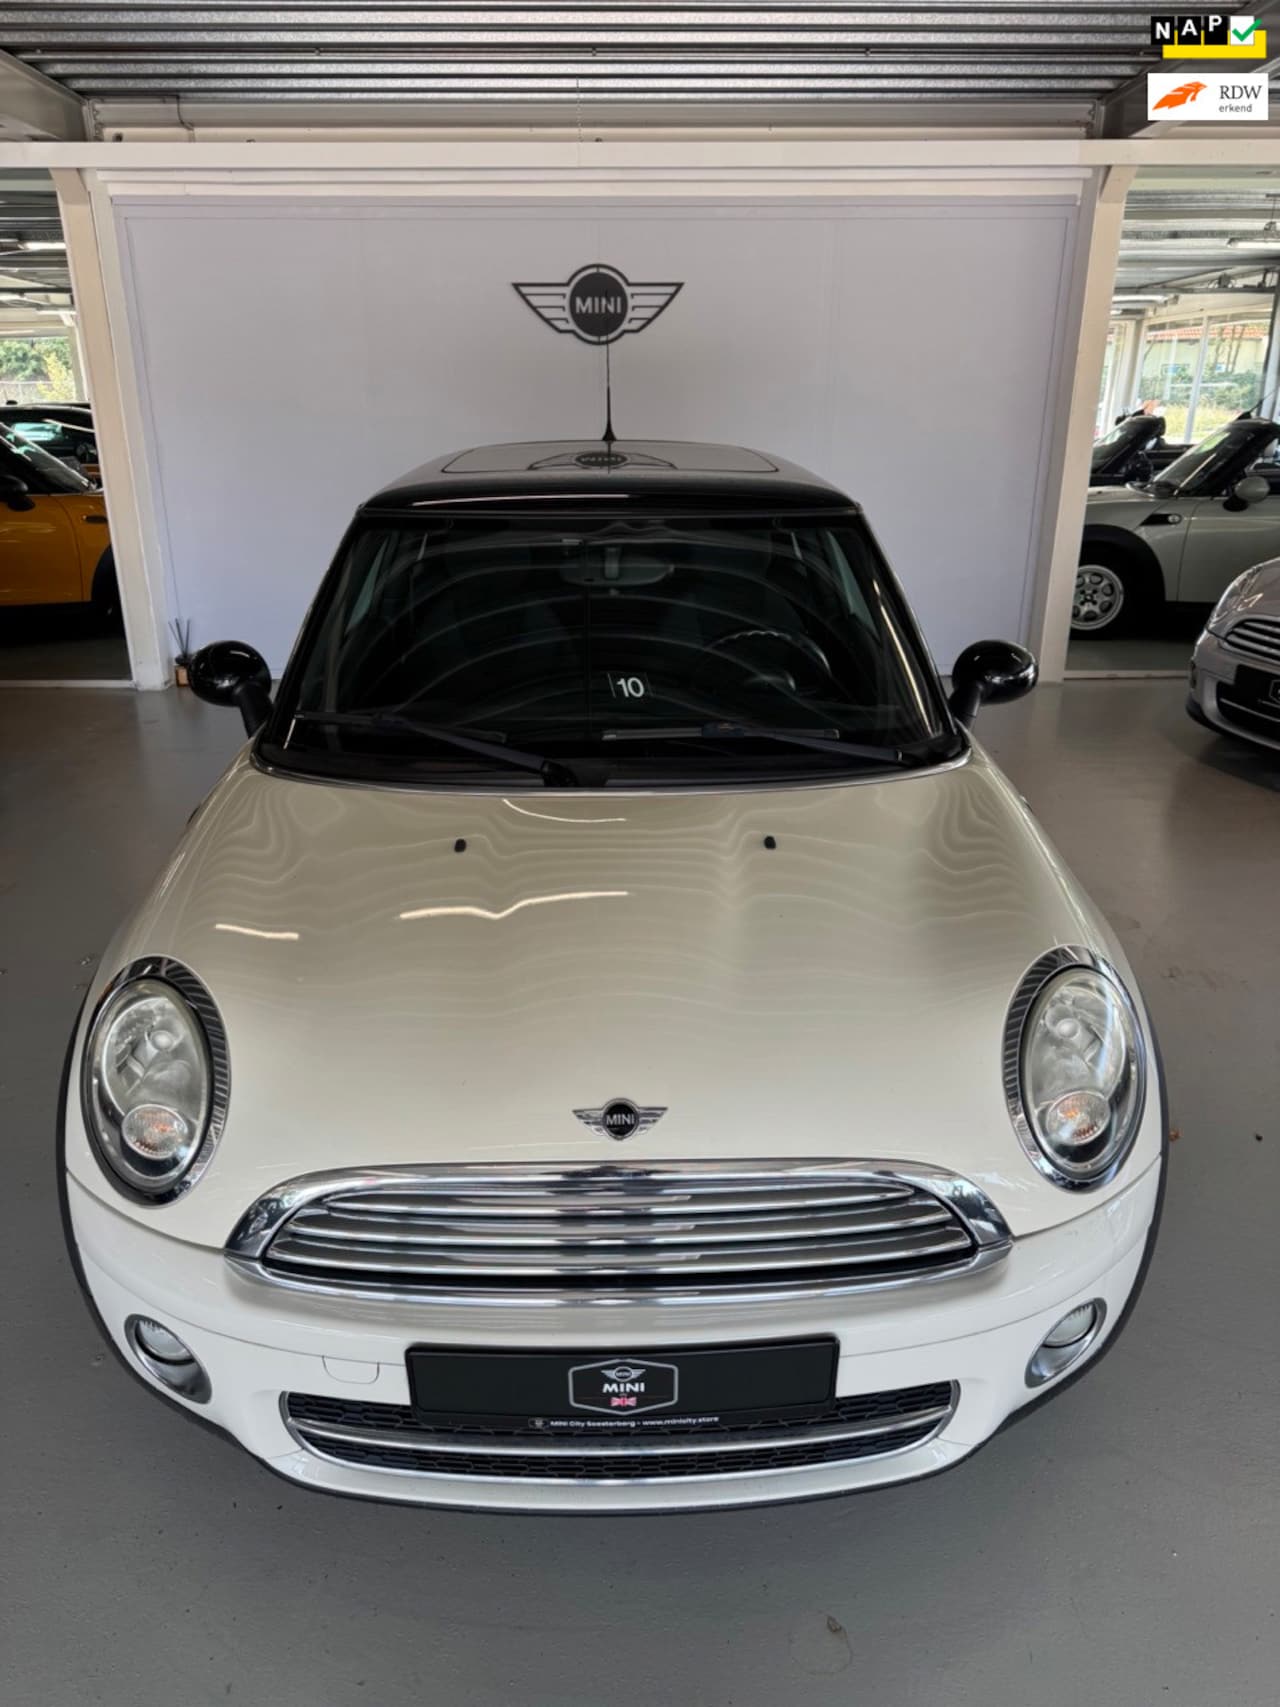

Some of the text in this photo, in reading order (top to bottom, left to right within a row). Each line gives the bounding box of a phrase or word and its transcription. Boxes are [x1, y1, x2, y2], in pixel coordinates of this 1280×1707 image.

[575, 297, 622, 314] MINI
[616, 677, 644, 698] 10
[606, 1113, 635, 1126] MINI
[602, 1382, 645, 1393] MINI
